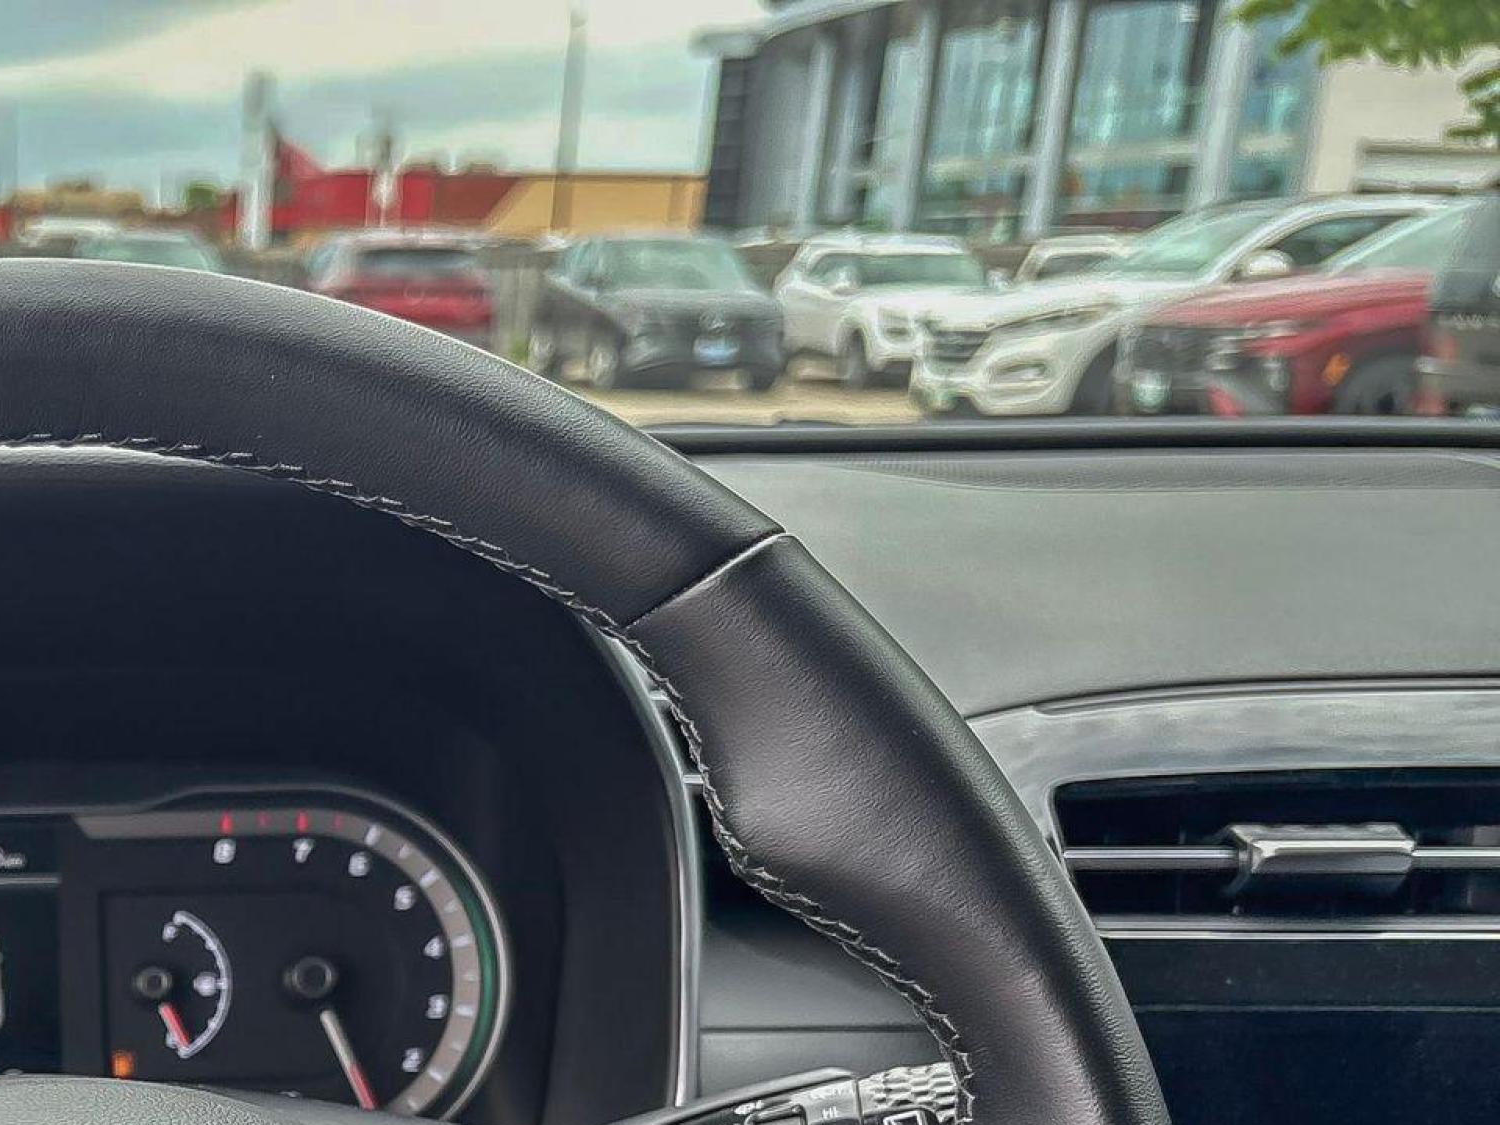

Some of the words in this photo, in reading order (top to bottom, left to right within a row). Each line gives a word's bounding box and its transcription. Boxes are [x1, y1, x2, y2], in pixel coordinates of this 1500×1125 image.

[293, 837, 315, 864] 7
[423, 935, 445, 960] 4
[402, 1047, 422, 1073] 2
